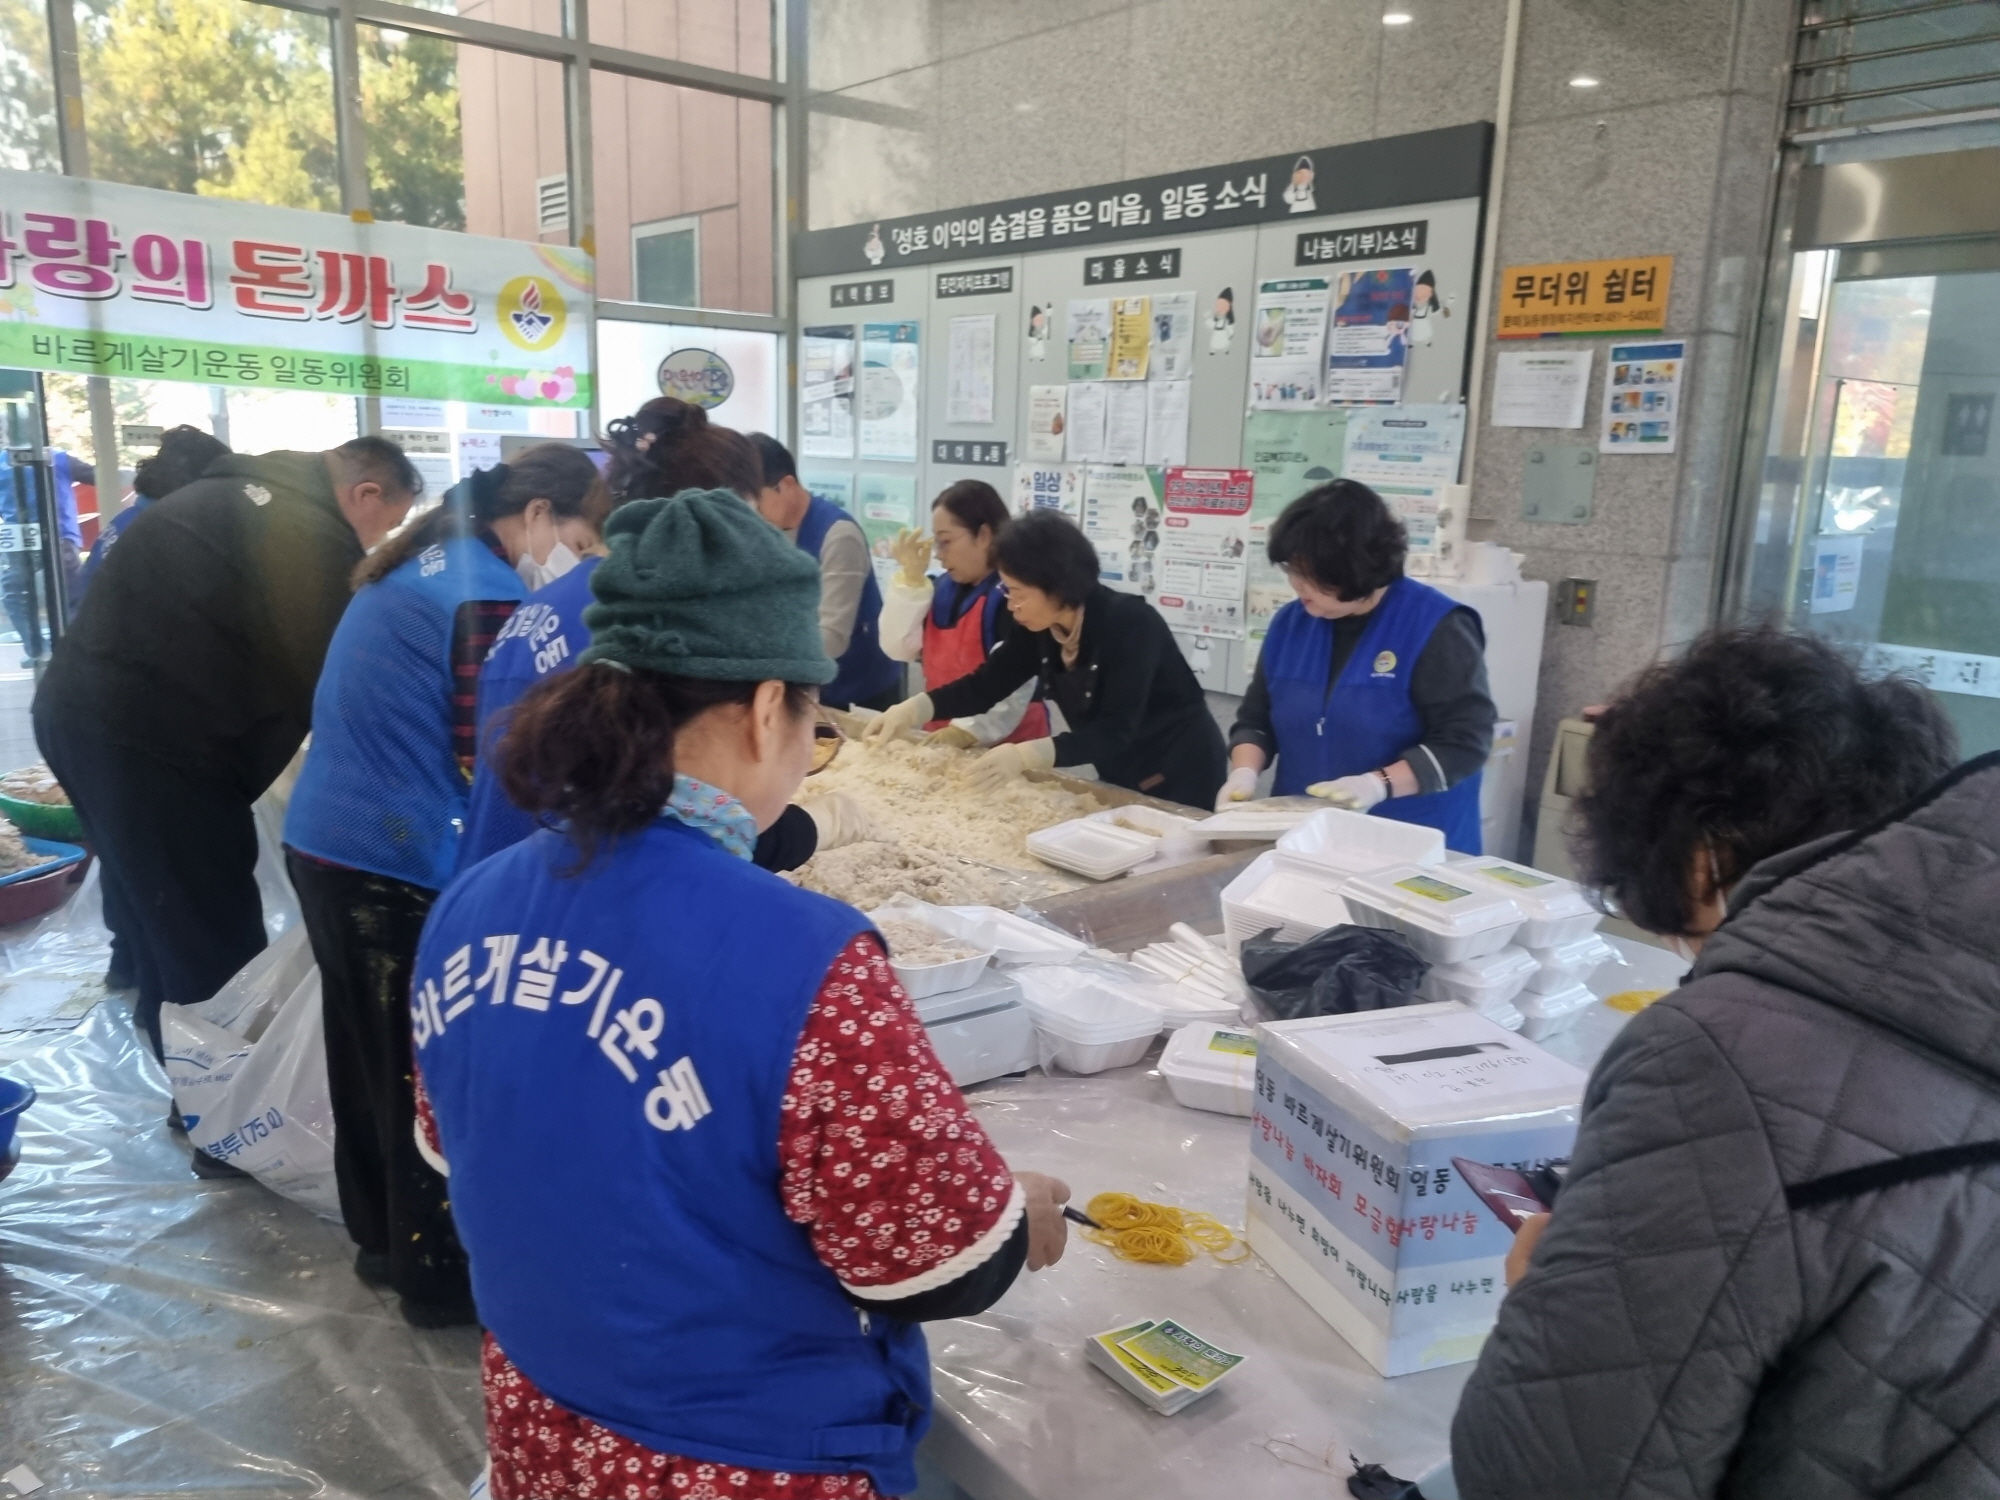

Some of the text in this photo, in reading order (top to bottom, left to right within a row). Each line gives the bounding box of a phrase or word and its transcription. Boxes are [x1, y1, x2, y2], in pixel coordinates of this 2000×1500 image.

[932, 217, 985, 249] 이익의
[988, 208, 1047, 244] 숨결을
[1051, 201, 1093, 235] 품은
[1098, 193, 1151, 228] 마을」
[1161, 183, 1209, 221] 일동
[1213, 172, 1267, 210] 소식
[1303, 226, 1418, 260] 나눔(기부)소식
[230, 240, 477, 333] 돈까스
[1512, 266, 1657, 308] 무더위 쉼터
[31, 333, 411, 391] 바르게살기운동 일동위원회
[1033, 471, 1061, 492] 일상
[1256, 1069, 1400, 1194] 일동 바르게살기위원회
[1303, 1152, 1342, 1200] 바자회
[1354, 1193, 1400, 1247] 모금함
[1410, 1168, 1451, 1197] 일동
[1278, 1198, 1306, 1235] 나누면
[1401, 1211, 1478, 1240] 사랑나눔
[1397, 1277, 1493, 1305] 사랑을 나누면
